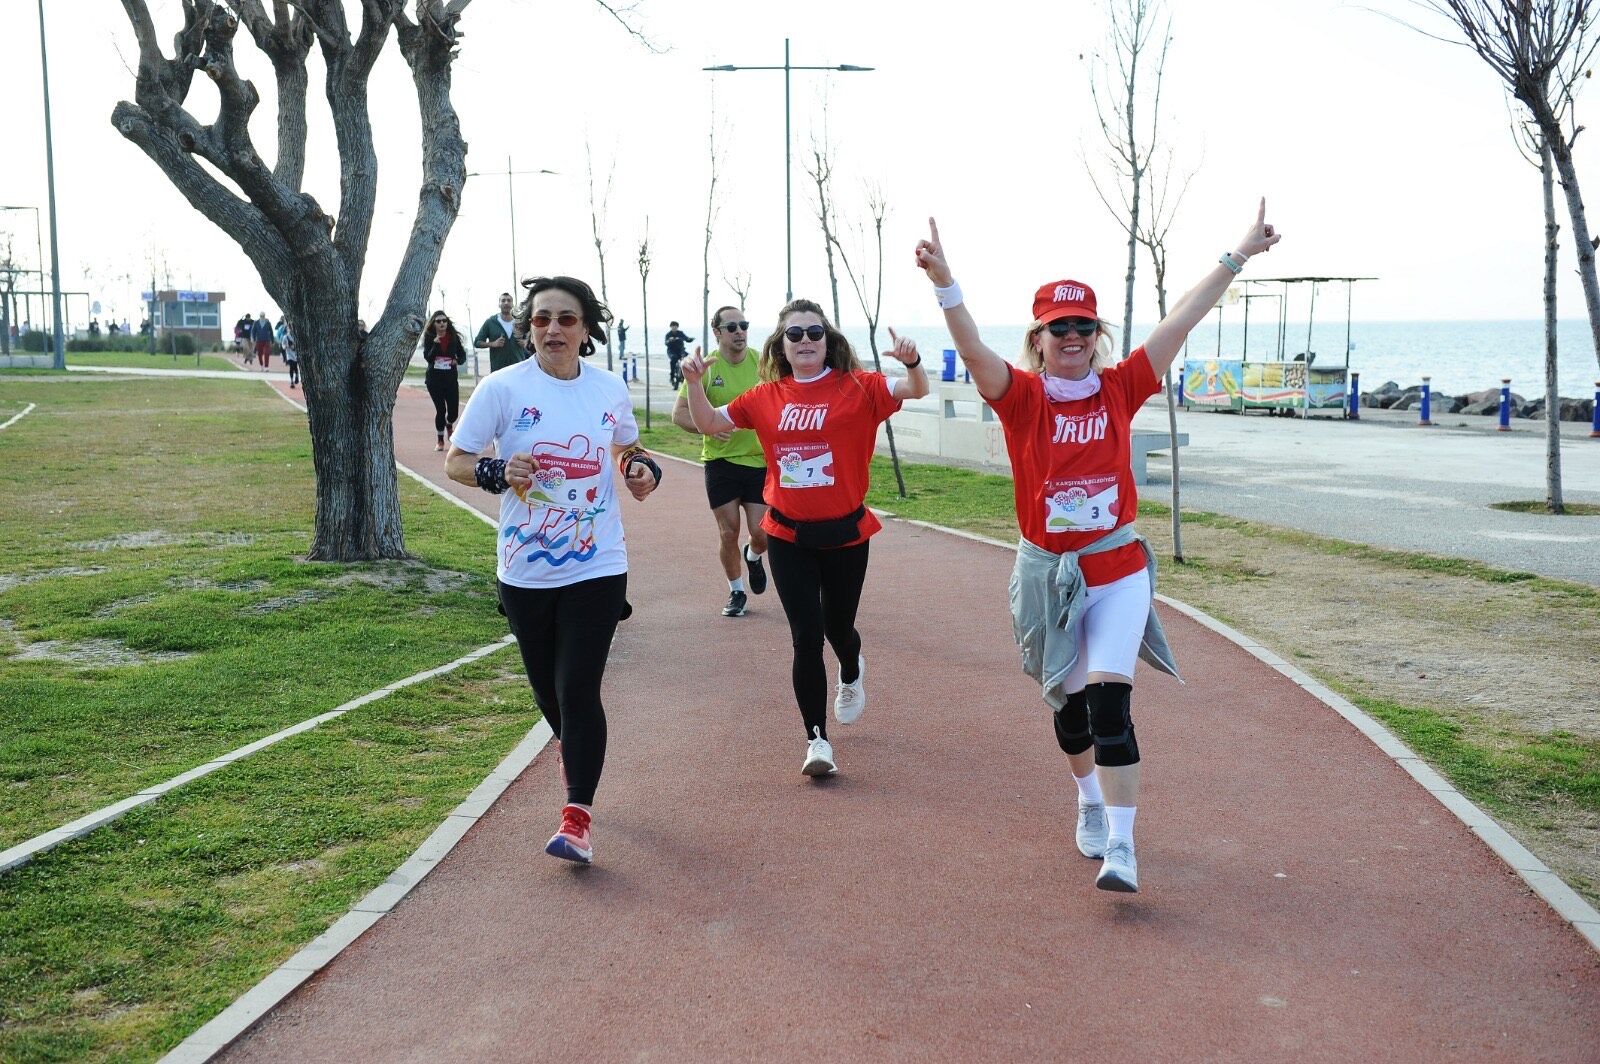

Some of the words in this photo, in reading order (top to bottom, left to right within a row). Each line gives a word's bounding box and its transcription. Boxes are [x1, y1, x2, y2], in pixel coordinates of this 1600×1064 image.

[1058, 287, 1085, 301] RUN
[784, 408, 827, 430] RUN
[1061, 412, 1107, 444] RUN
[807, 468, 813, 477] 7
[568, 489, 576, 500] 6
[1092, 507, 1099, 519] 3
